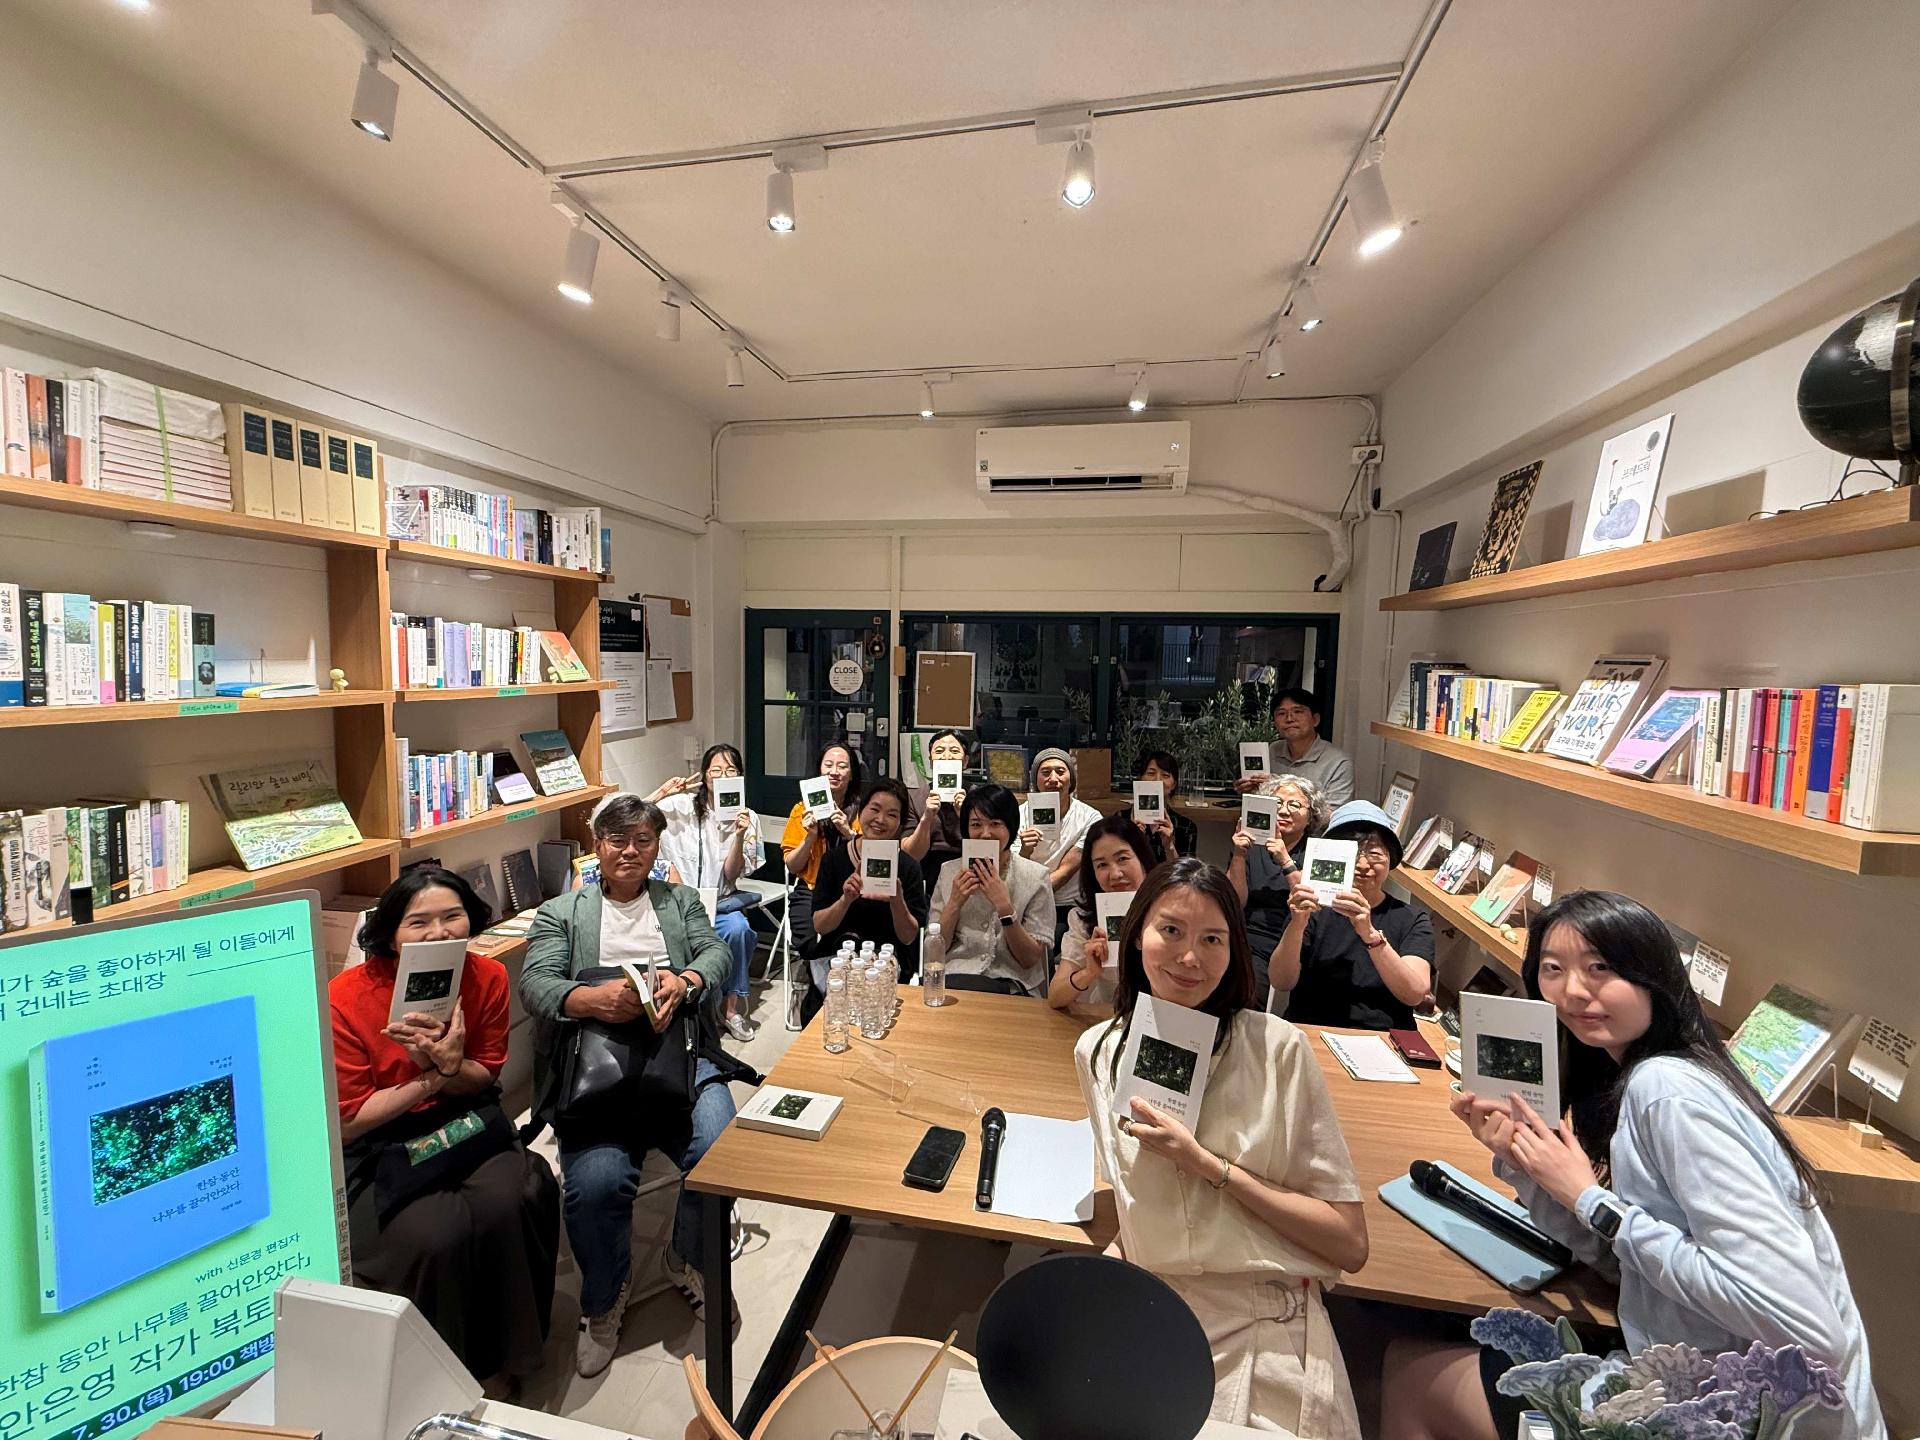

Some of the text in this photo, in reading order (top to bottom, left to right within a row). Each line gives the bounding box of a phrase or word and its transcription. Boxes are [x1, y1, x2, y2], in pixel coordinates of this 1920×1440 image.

[834, 666, 859, 674] CLOSE
[1572, 691, 1632, 718] THINGS
[9, 839, 19, 859] URBAN
[10, 859, 21, 883] JUNGLE
[0, 925, 295, 998] 가 숲을 좋아하게 될 이들에게
[16, 989, 91, 1017] 건네는
[98, 971, 167, 1000] 초대장
[152, 1181, 241, 1223] 나무를 끌어안았다
[195, 1232, 301, 1283] with 신문경 편집자
[57, 1336, 110, 1374] 동안
[118, 1301, 191, 1346] 나무를
[0, 1294, 274, 1440] 안은영 작가 북토
[178, 1356, 236, 1392] 19:00
